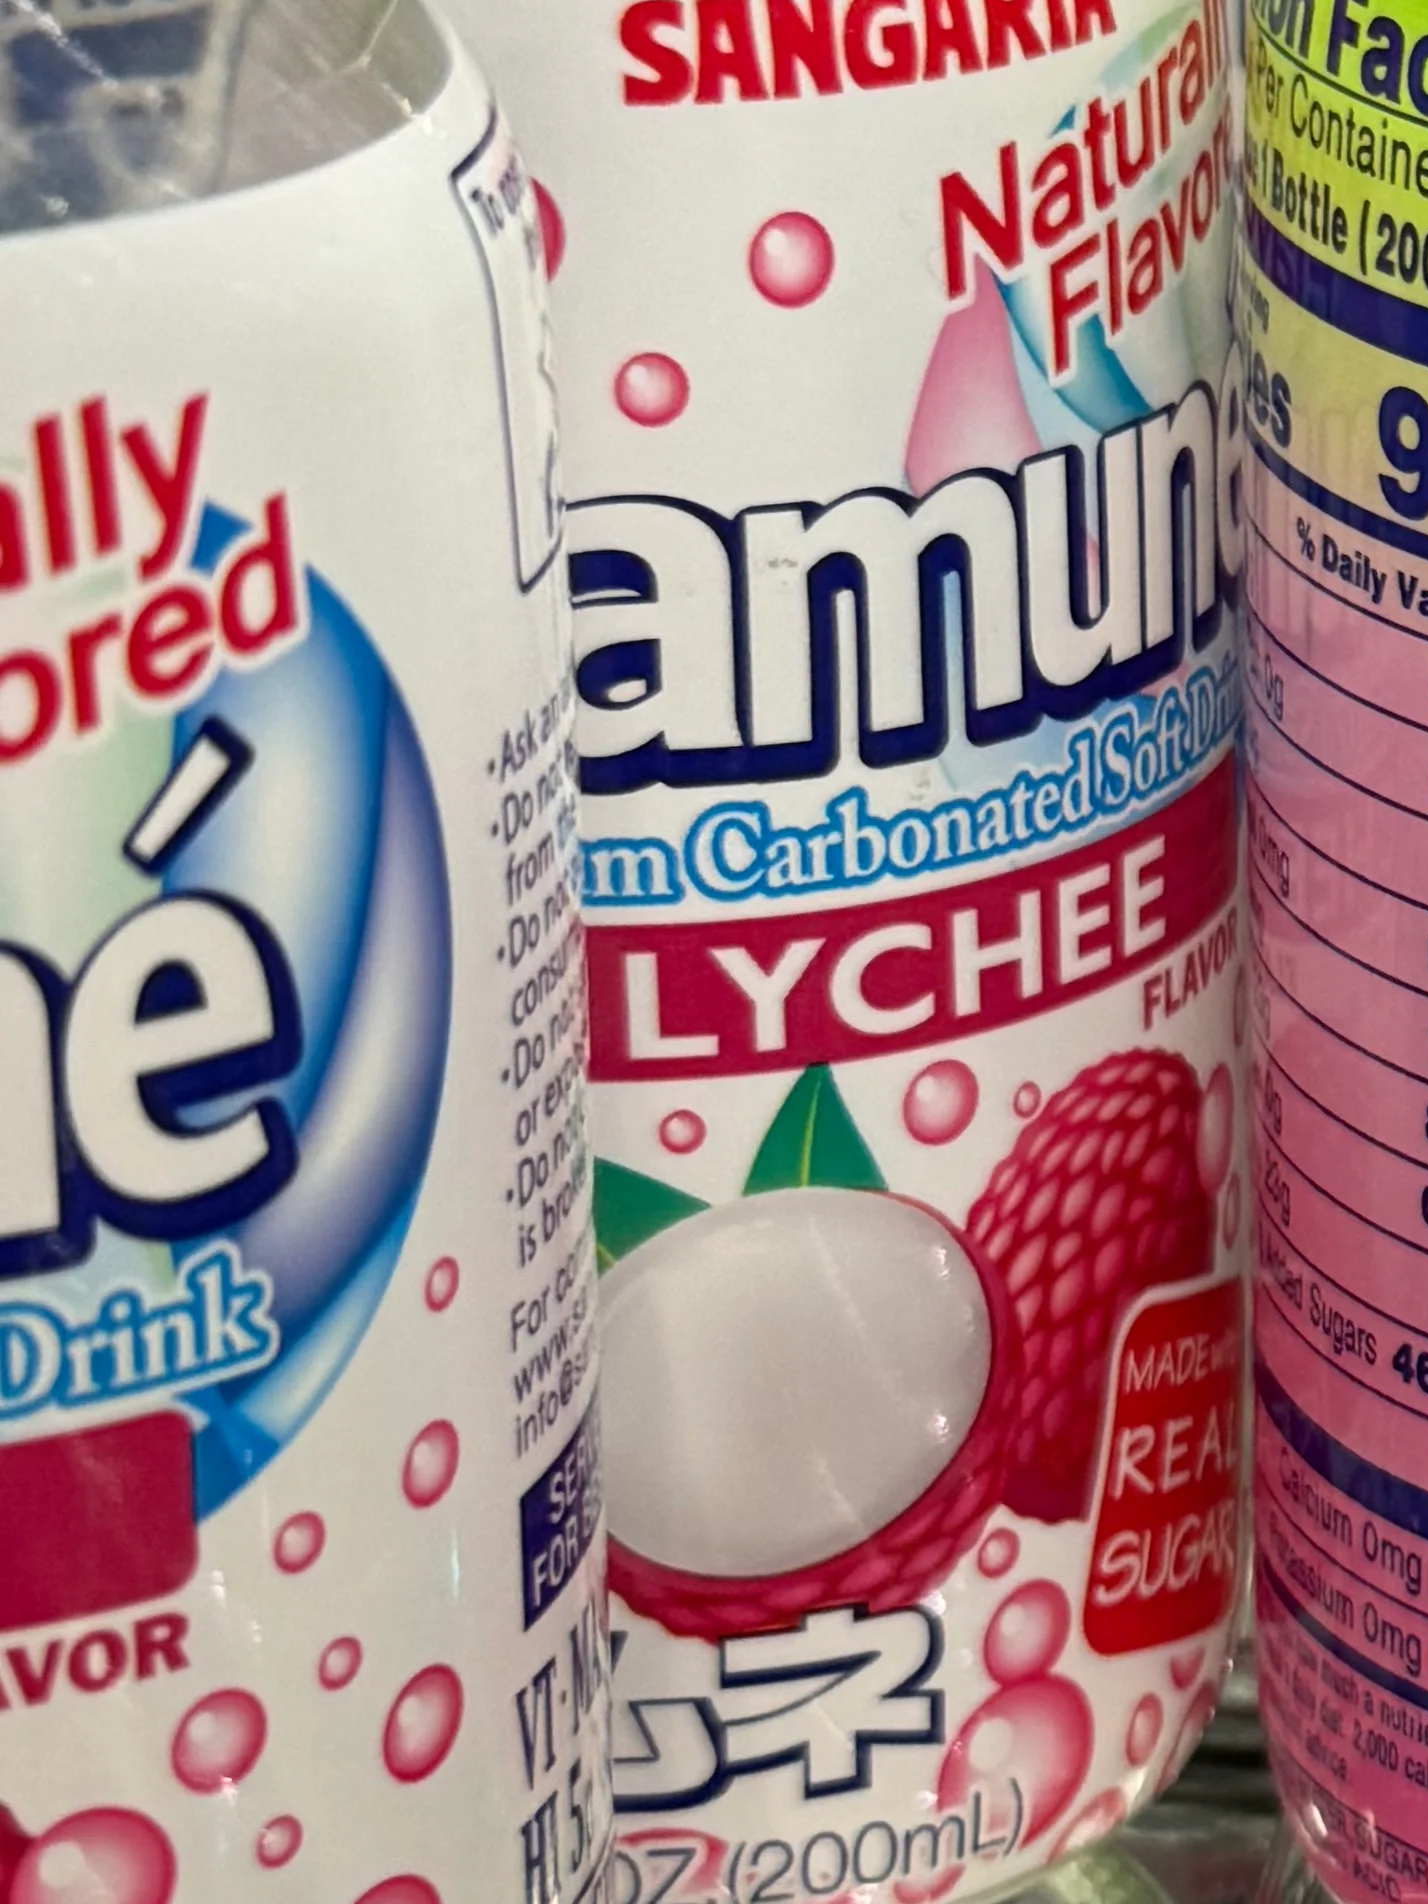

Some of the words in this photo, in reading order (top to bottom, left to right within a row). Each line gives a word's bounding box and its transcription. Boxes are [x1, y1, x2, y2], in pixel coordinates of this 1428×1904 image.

[1272, 146, 1350, 255] Bottle
[1322, 533, 1388, 605] Daily
[500, 708, 538, 784] Ask
[685, 729, 1098, 902] Carbonated
[1101, 694, 1187, 806] Soft
[506, 830, 555, 908] from
[624, 832, 1167, 1063] LYCHEE
[1141, 904, 1239, 1032] FLAVOR
[1125, 1332, 1210, 1395] MADE
[1308, 1284, 1378, 1367] Sugars
[1093, 1499, 1237, 1608] SUGAR
[1280, 1448, 1353, 1549] Calcium
[1362, 1519, 1423, 1597] 0mg
[1362, 1604, 1423, 1680] 0mg
